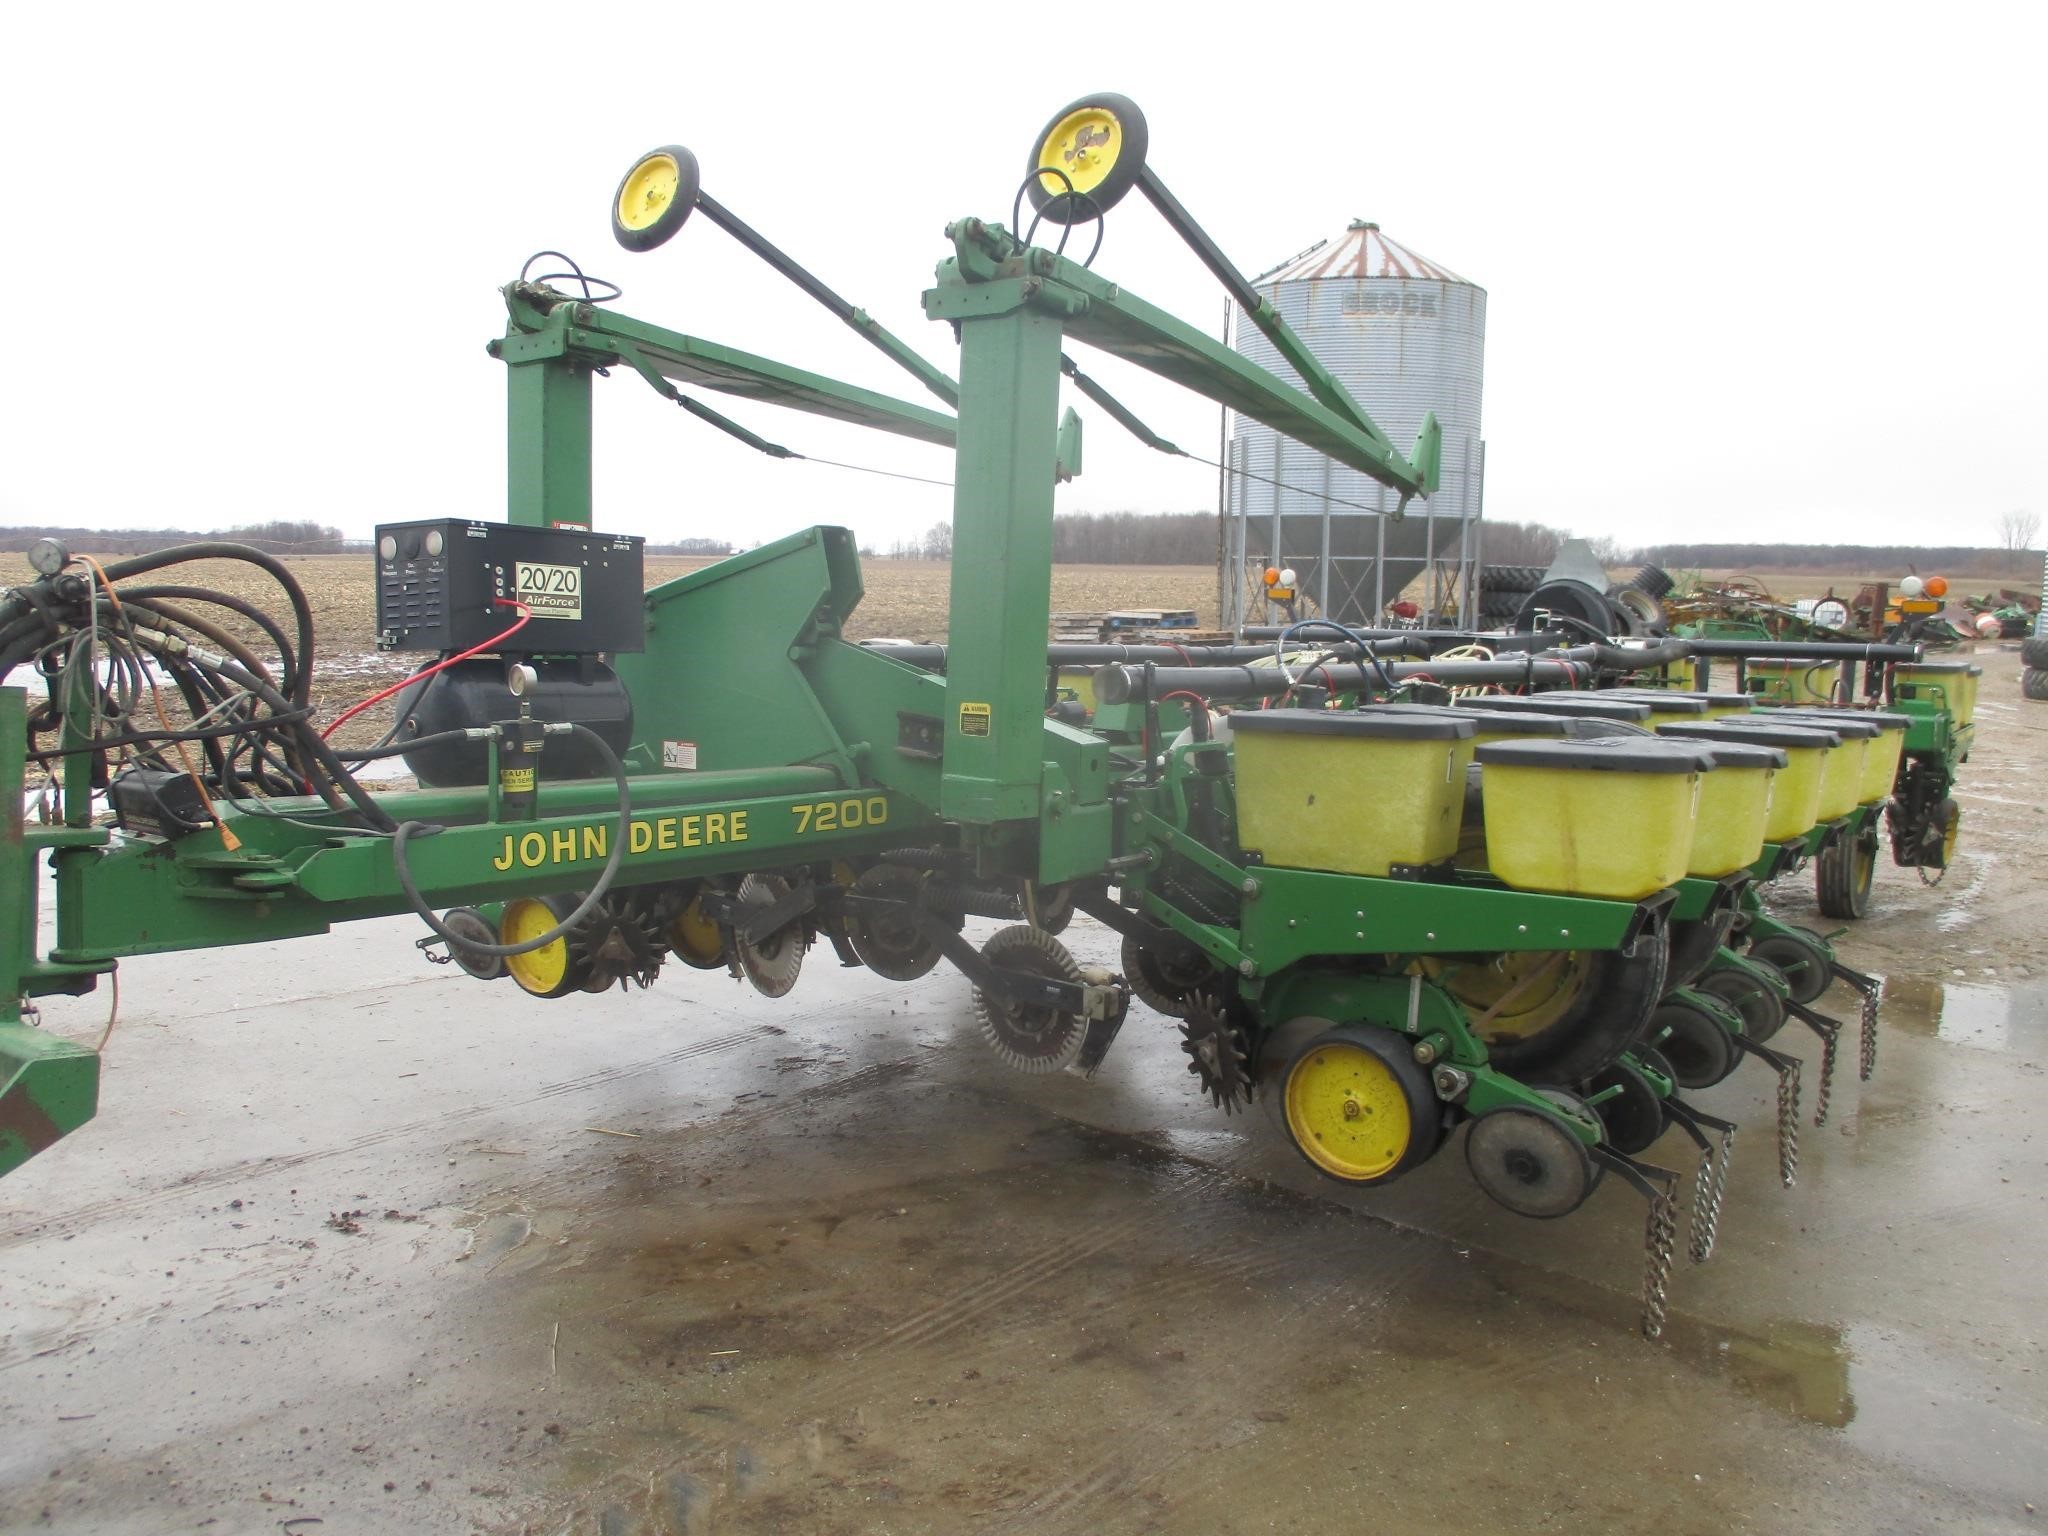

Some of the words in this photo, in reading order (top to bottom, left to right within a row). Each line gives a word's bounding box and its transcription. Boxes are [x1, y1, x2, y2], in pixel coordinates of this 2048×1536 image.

[1342, 291, 1439, 317] BROCK
[520, 566, 578, 593] 20/20
[524, 595, 575, 607] AirForce
[493, 824, 607, 872] JOHN
[628, 810, 749, 855] DEERE
[791, 796, 889, 834] 7200
